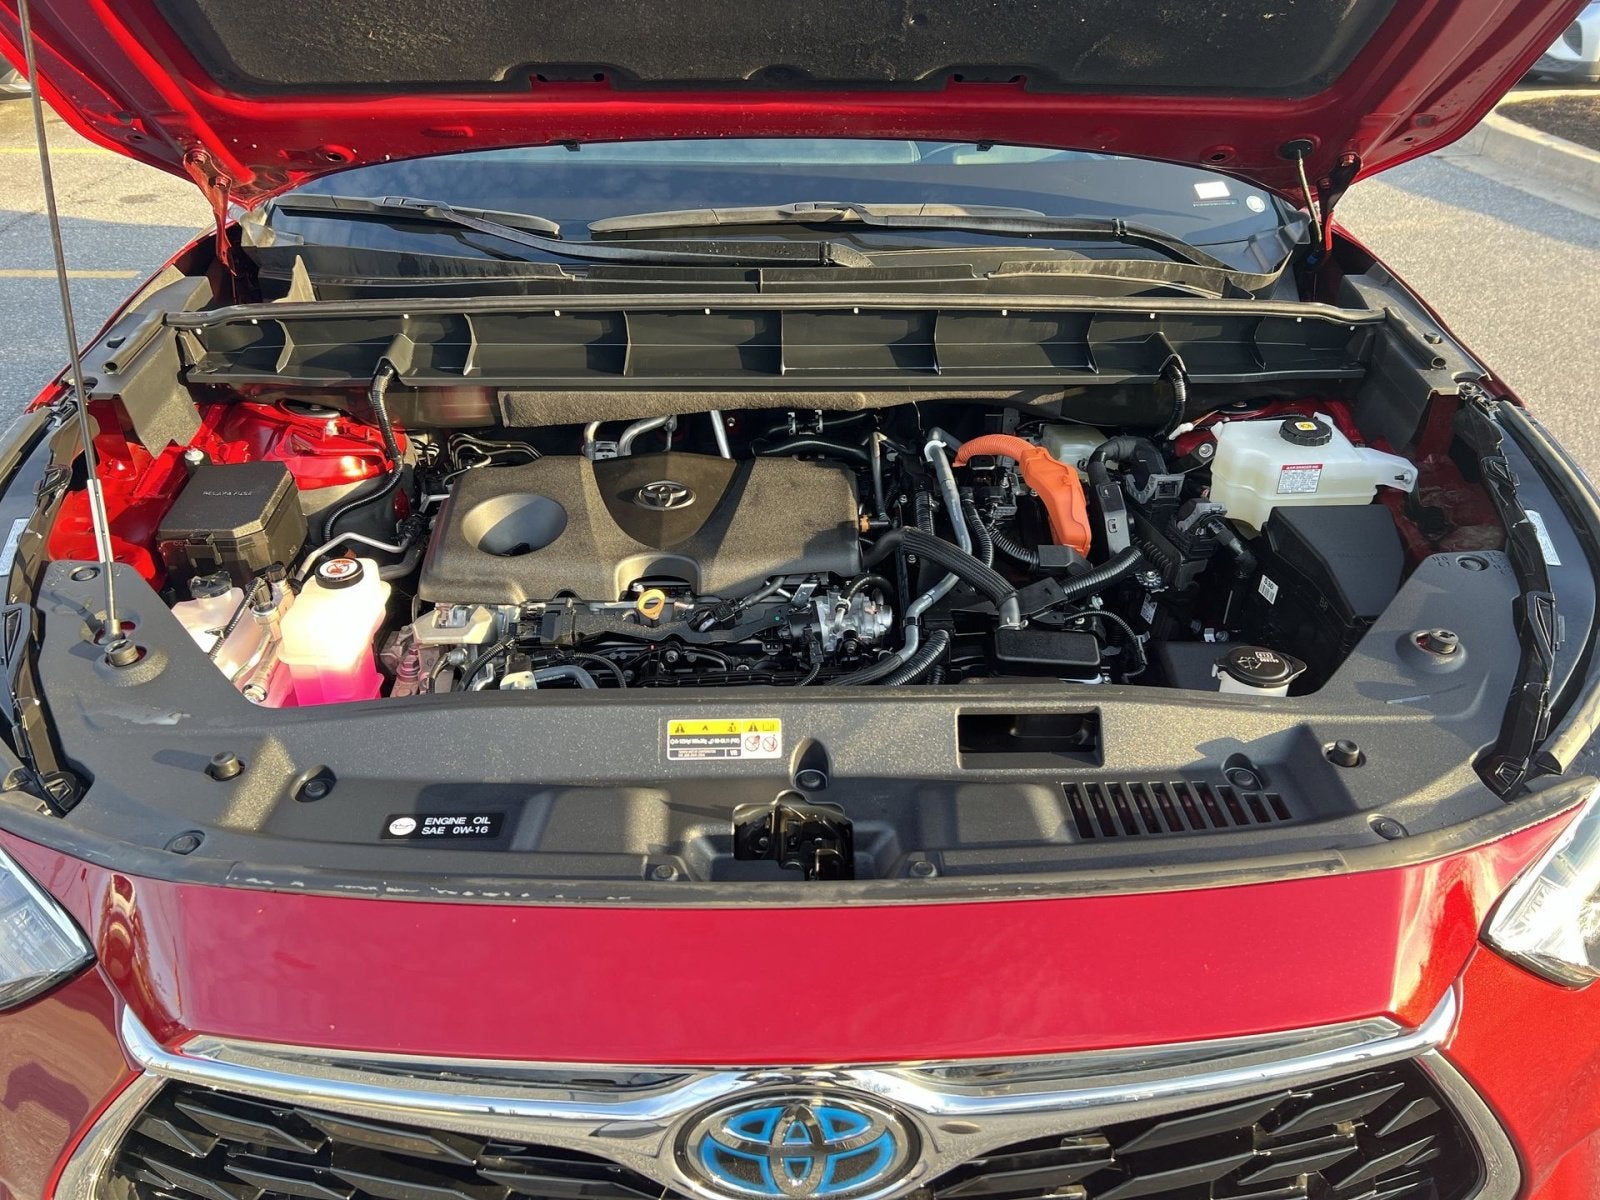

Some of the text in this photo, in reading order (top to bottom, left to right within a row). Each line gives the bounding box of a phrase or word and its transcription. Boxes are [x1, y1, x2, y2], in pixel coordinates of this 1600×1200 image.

[424, 816, 491, 825] ENGINE OIL
[421, 825, 488, 835] SAE 0W-16
